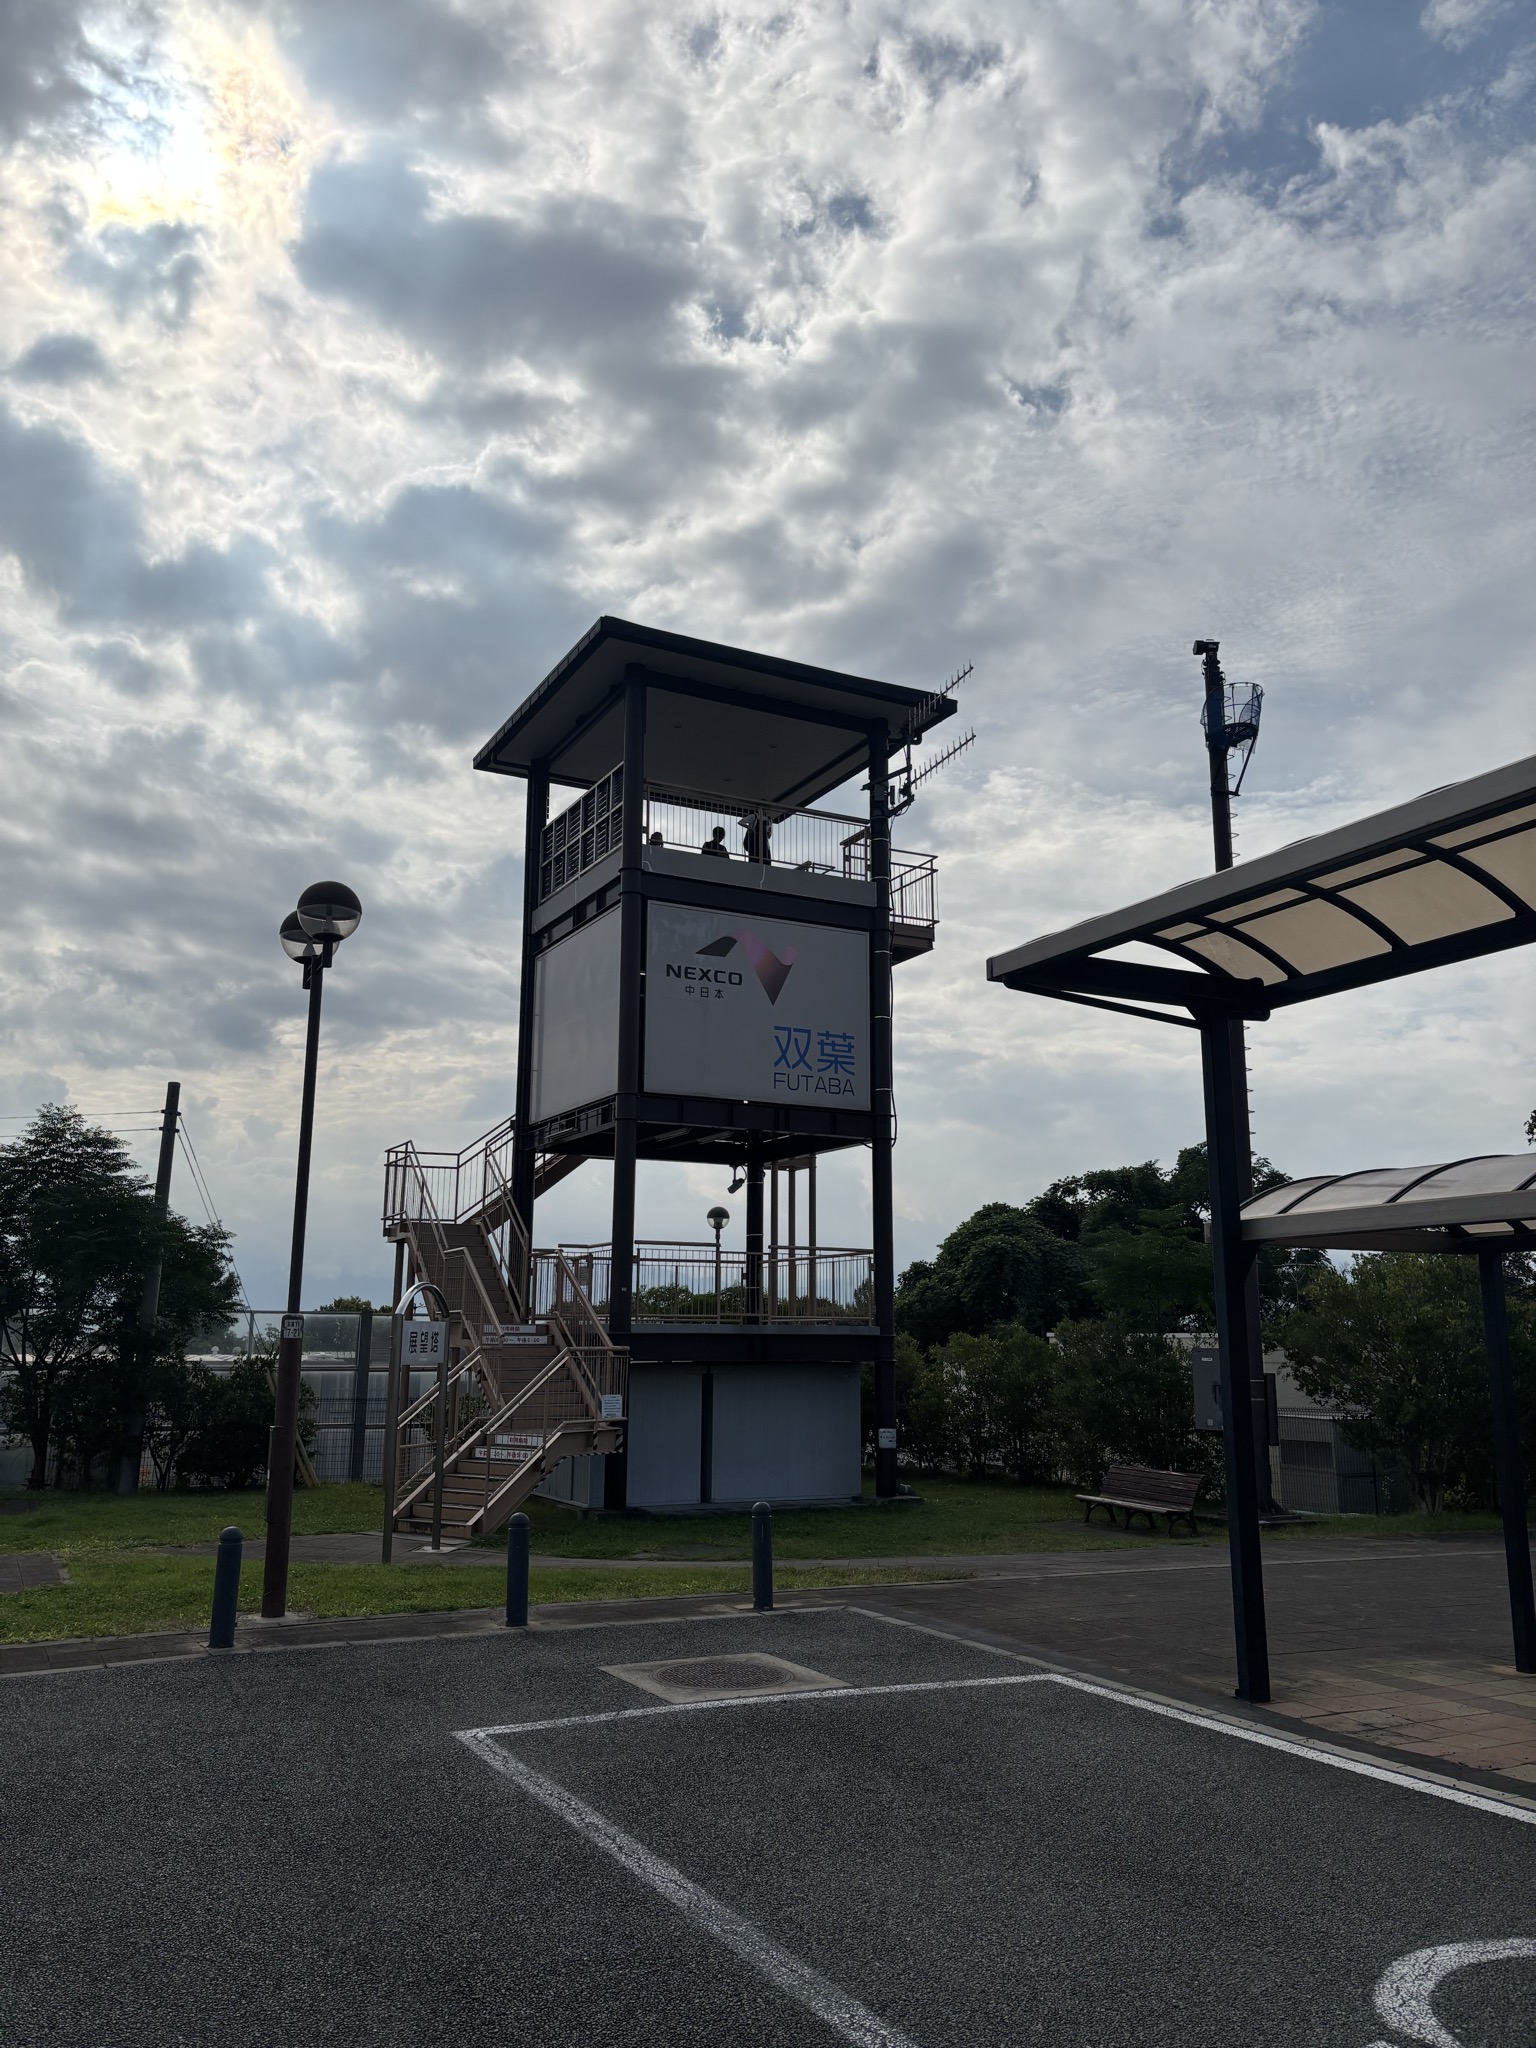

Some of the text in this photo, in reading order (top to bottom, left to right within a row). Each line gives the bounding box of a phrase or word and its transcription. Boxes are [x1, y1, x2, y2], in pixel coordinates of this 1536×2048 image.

[666, 964, 743, 985] NEXCO
[685, 985, 724, 999] 中日本
[773, 1025, 855, 1075] 双葉
[773, 1072, 855, 1096] FUTABA
[408, 1331, 439, 1354] 展望塔
